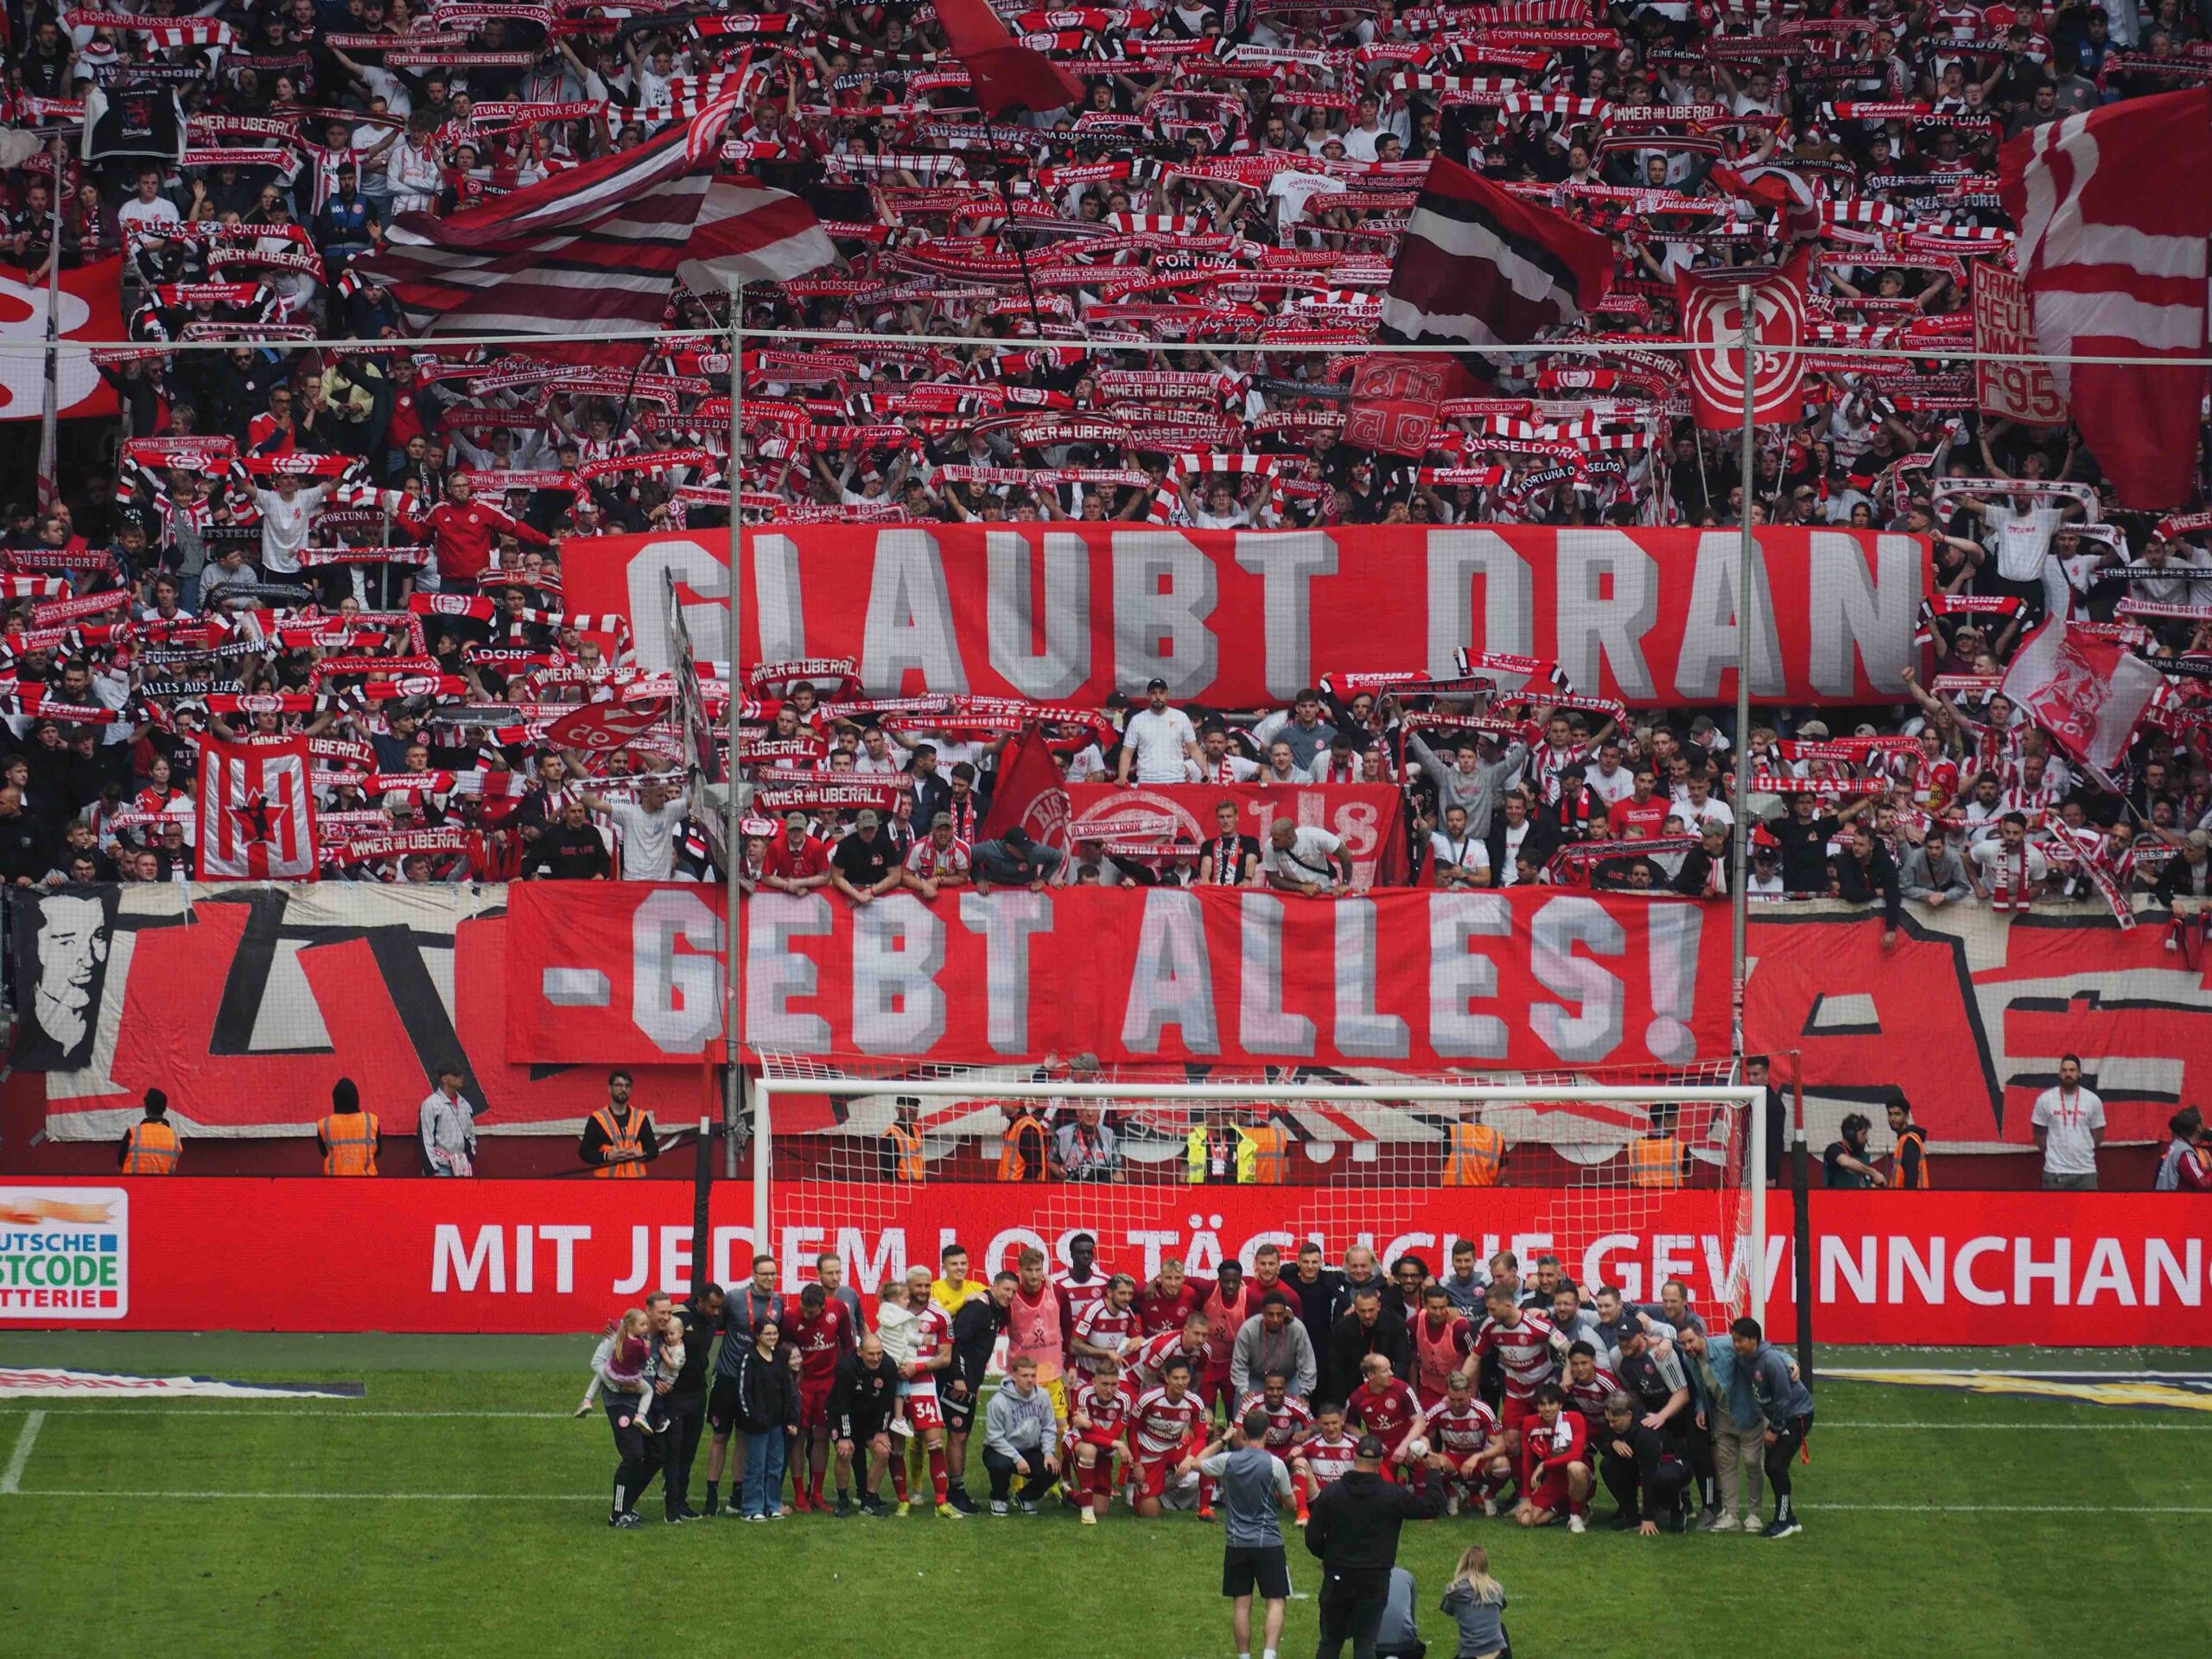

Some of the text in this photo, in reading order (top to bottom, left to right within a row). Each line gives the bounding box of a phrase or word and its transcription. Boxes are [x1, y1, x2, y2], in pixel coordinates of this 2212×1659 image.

[83, 10, 135, 26] FORTUNA
[328, 35, 378, 46] FORTUNA
[1492, 29, 1611, 42] FORTUNA DÜSSELDORF
[388, 54, 531, 65] FORTUNA UNBESIEGBAR
[1236, 47, 1319, 60] Fortuna Düsseldorf
[1674, 49, 1705, 60] HEIMAT
[565, 105, 588, 116] FÜR
[1089, 113, 1141, 122] FORTUNA
[1613, 105, 1650, 121] IMMER
[1912, 114, 1991, 127] FORTUNA
[1173, 163, 1240, 181] SEIT 1895
[1866, 176, 1905, 191] FORZA
[1317, 194, 1369, 204] FORTUNA
[1654, 195, 1726, 213] Düsseldorf
[208, 250, 245, 265] IMMER
[1155, 256, 1237, 270] FORTUNA
[1265, 253, 1300, 265] FORTUNA
[1838, 252, 1936, 263] FORTUNA 1895
[1239, 272, 1314, 286] SEIT 1895
[1292, 303, 1346, 318] Support
[1261, 319, 1288, 329] 1895
[686, 343, 713, 353] RHEIN
[898, 345, 928, 356] RHEIN
[664, 374, 702, 388] 1895
[1104, 372, 1181, 384] MEINE STADT MEIN
[1102, 384, 1142, 399] IMMER
[1978, 359, 2064, 419] F95
[1475, 401, 1528, 413] DÜSSELDORF
[128, 442, 173, 451] FORTUNA
[629, 451, 707, 467] DÜSSELDORF
[467, 475, 507, 486] FORTUNA
[950, 467, 1024, 480] MEINE STADT MEIN
[1433, 467, 1491, 482] Fortuna
[1520, 470, 1566, 493] FORTUNA
[856, 503, 891, 517] 1895
[323, 511, 370, 524] FORTUNA
[16, 554, 99, 569] DÜSSELDORF
[2104, 569, 2158, 579] FORTUNA
[626, 527, 1922, 702] GLAUBT DRAN
[133, 621, 176, 636] NUMMER
[144, 647, 188, 664] FORZA
[142, 679, 208, 696] ALLES AUS
[1344, 672, 1414, 690] Fortuna
[969, 705, 1092, 722] FORTUNA
[830, 772, 910, 787] UNBESIEGBAR
[1758, 779, 1851, 793] ULTRAS
[762, 788, 801, 807] IMMER
[351, 836, 393, 857] IMMER
[1108, 844, 1159, 856] FORTUNA
[1994, 845, 2010, 890] IMMER
[1122, 887, 1703, 1065] ALLES!
[431, 1224, 591, 1294] MIT
[613, 1225, 906, 1294] JEDEM
[915, 1402, 935, 1419] 34
